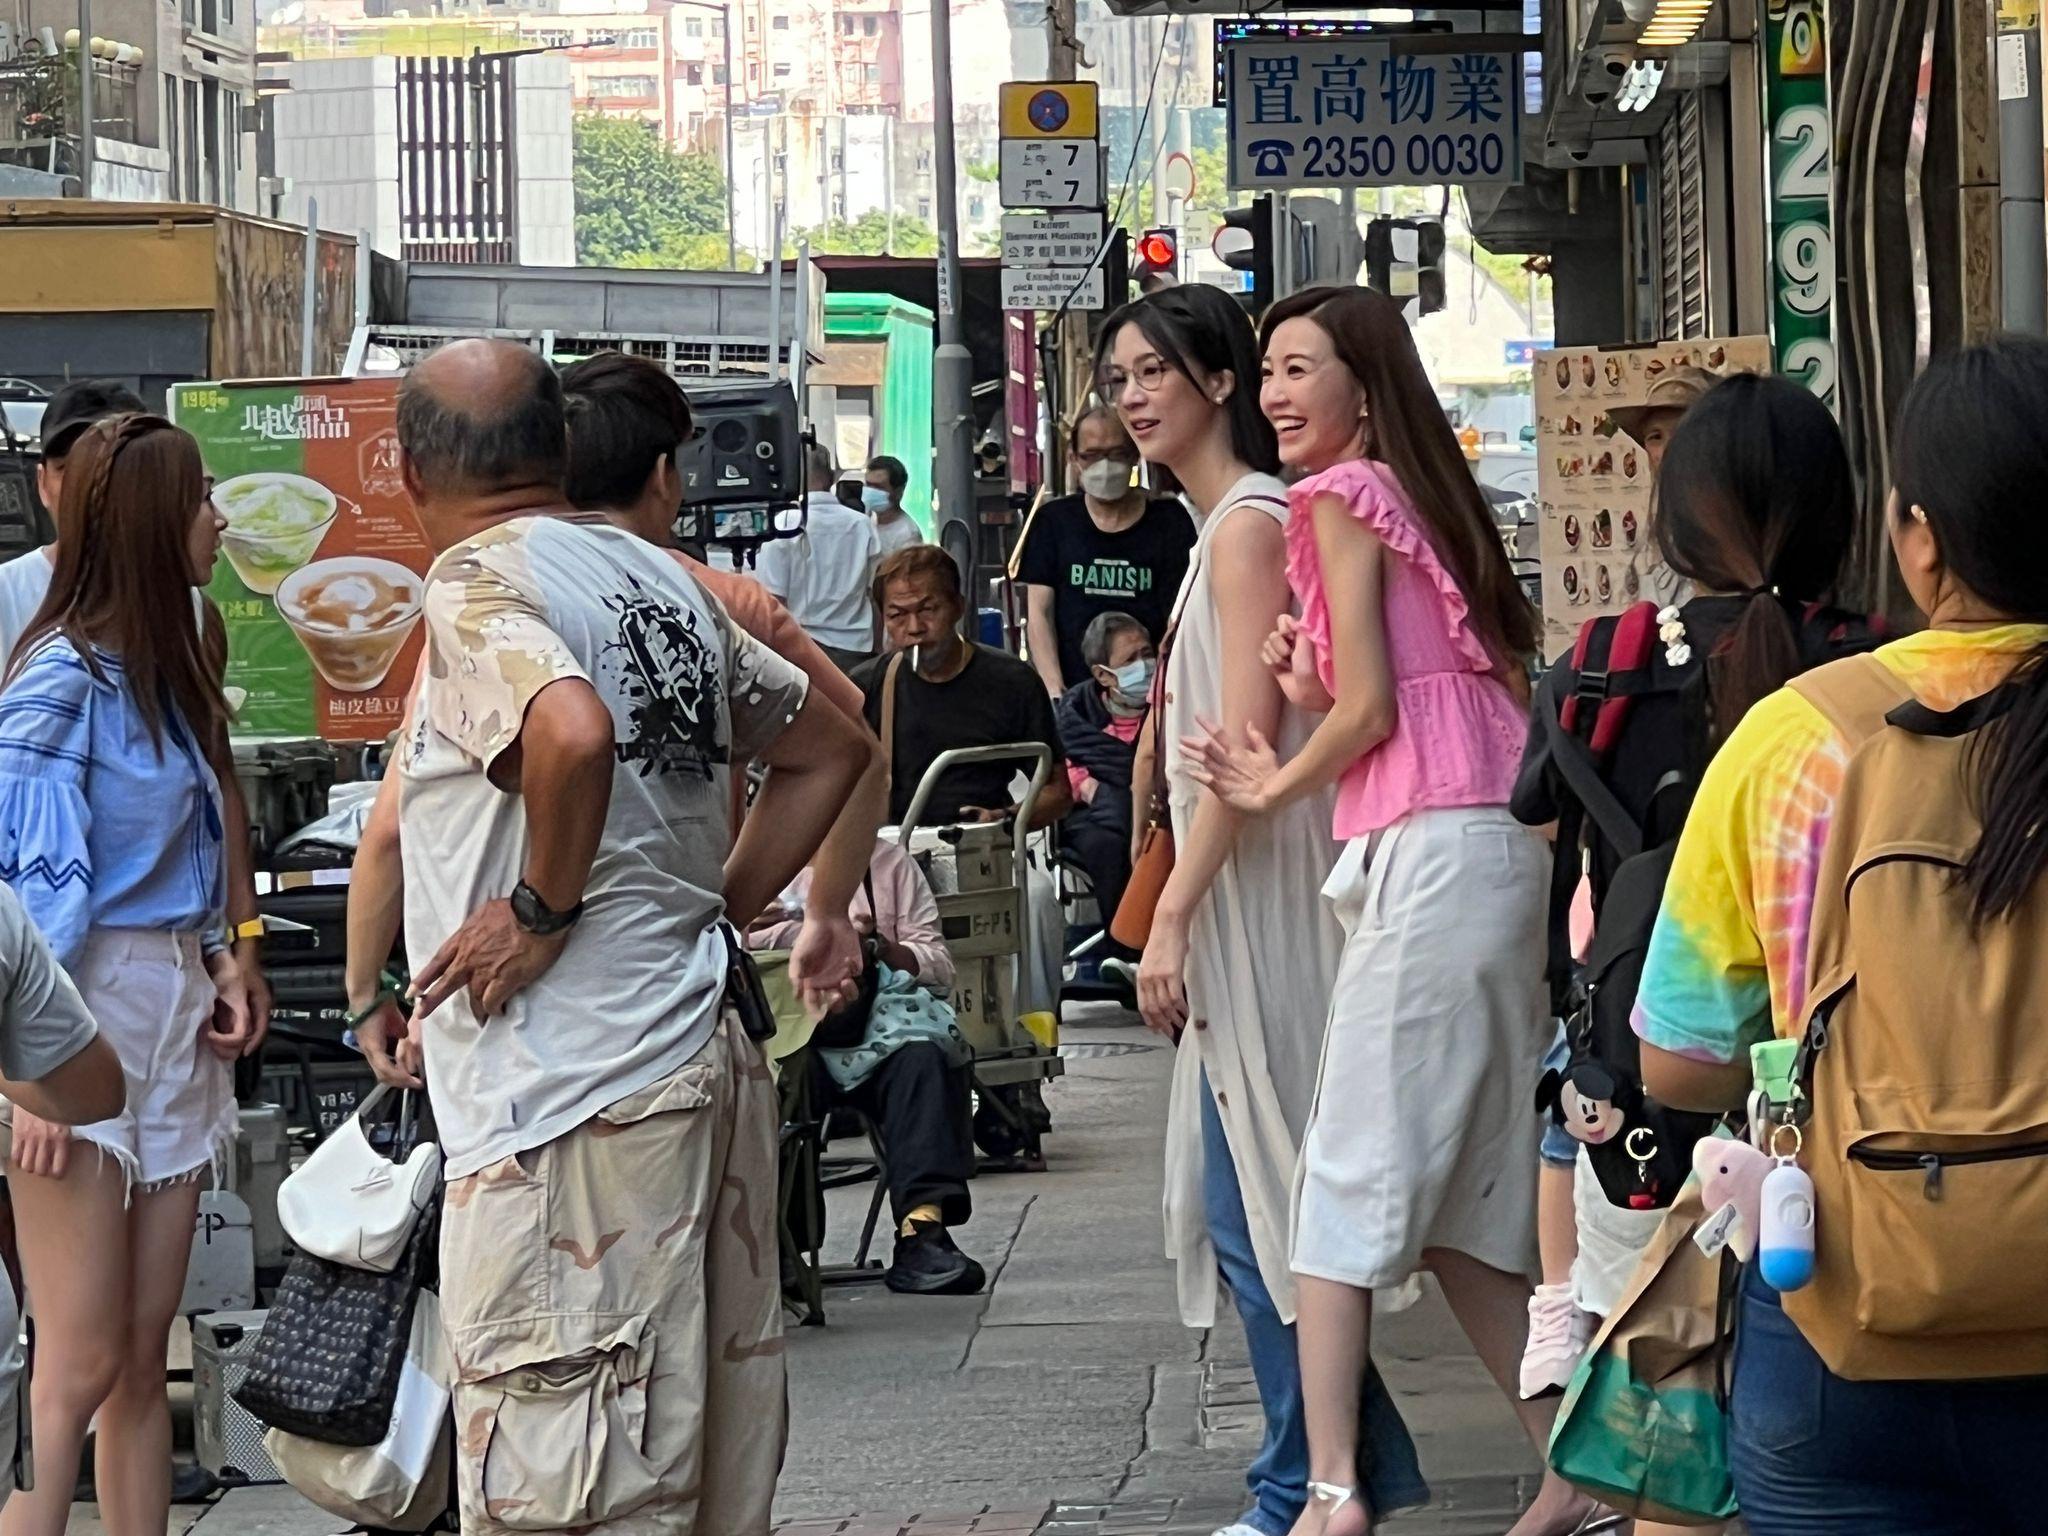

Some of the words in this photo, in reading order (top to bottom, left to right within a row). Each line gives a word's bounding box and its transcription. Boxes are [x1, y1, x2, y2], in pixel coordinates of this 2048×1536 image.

[1246, 54, 1503, 125] 置高物業
[1063, 145, 1079, 166] 7
[1303, 136, 1395, 178] 2350
[1407, 134, 1504, 176] 0030
[1064, 180, 1079, 202] 7
[1070, 563, 1153, 592] BANISH
